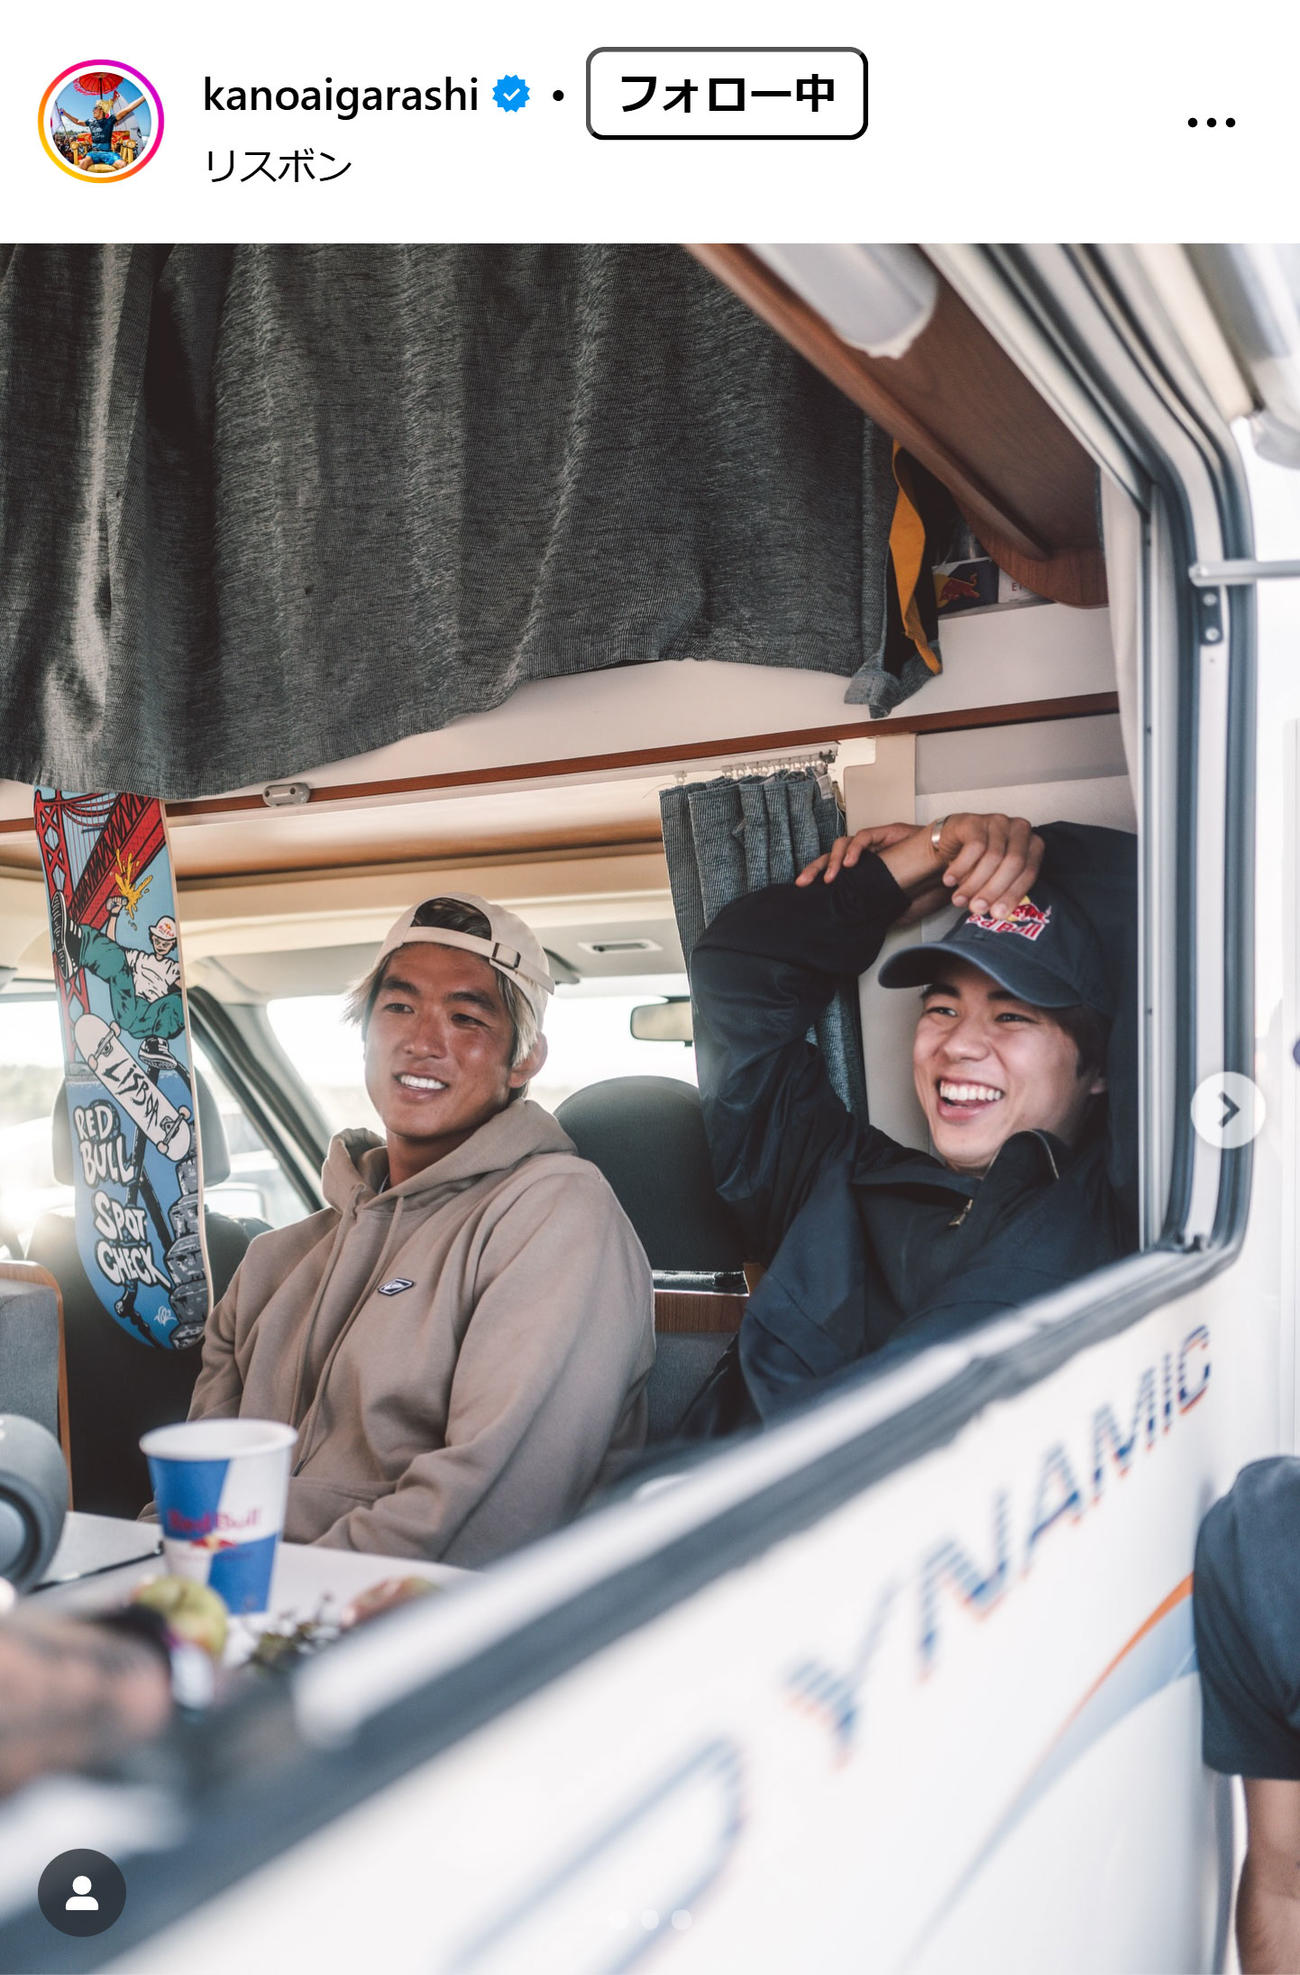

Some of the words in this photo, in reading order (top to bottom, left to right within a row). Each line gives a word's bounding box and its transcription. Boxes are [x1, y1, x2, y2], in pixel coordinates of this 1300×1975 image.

[73, 1102, 117, 1140] RED
[80, 1134, 134, 1186] BULL
[93, 1190, 147, 1242] SPOT
[97, 1240, 171, 1289] CHECK
